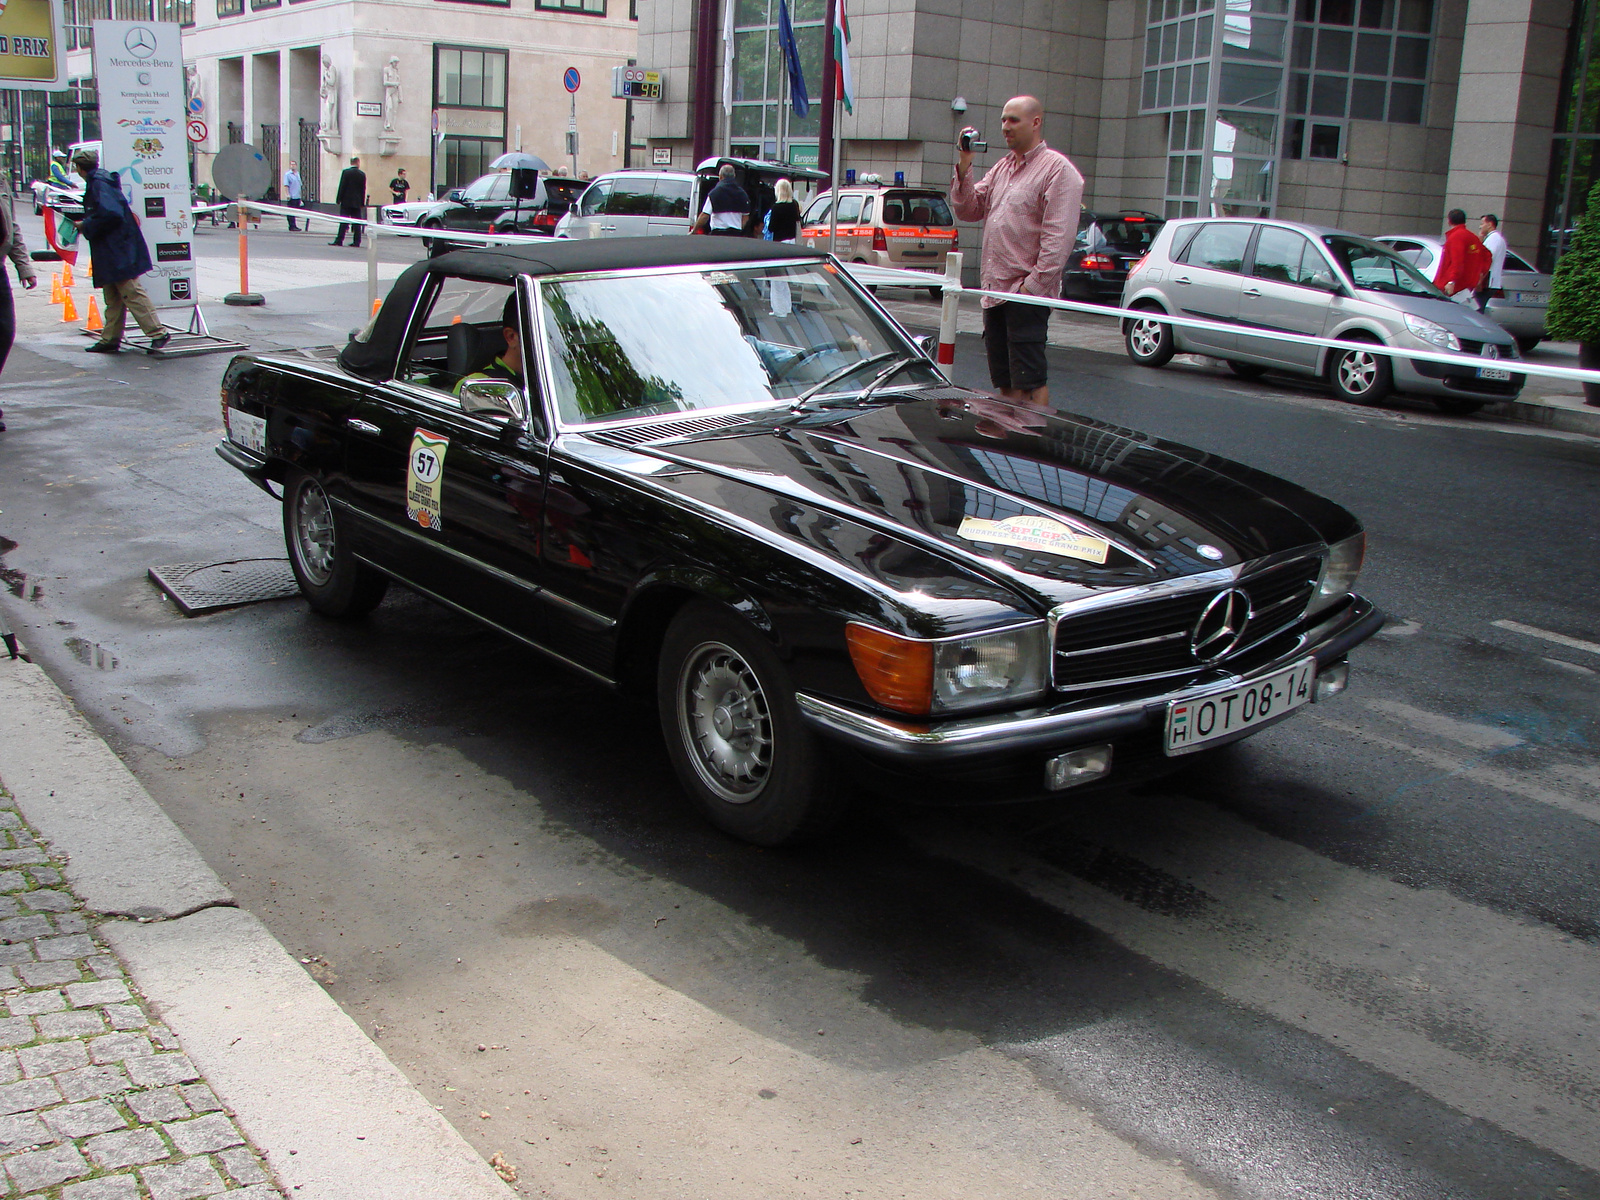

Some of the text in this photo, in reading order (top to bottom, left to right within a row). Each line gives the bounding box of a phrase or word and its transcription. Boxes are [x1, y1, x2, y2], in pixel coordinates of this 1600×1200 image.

[12, 36, 49, 57] PRIX
[109, 58, 174, 68] Mercedes-Benz
[121, 91, 152, 99] Kempinski
[641, 83, 660, 98] 98
[135, 152, 163, 160] ZWACK
[144, 166, 174, 176] telenor
[143, 182, 171, 190] SOLIDE
[417, 453, 435, 476] 57
[1011, 526, 1061, 540] BPCGP
[964, 527, 1009, 538] BUDAPEST
[1011, 533, 1047, 545] CLASSIC
[1049, 540, 1079, 551] GRAND
[1081, 547, 1102, 556] PRIX
[1173, 725, 1186, 743] H
